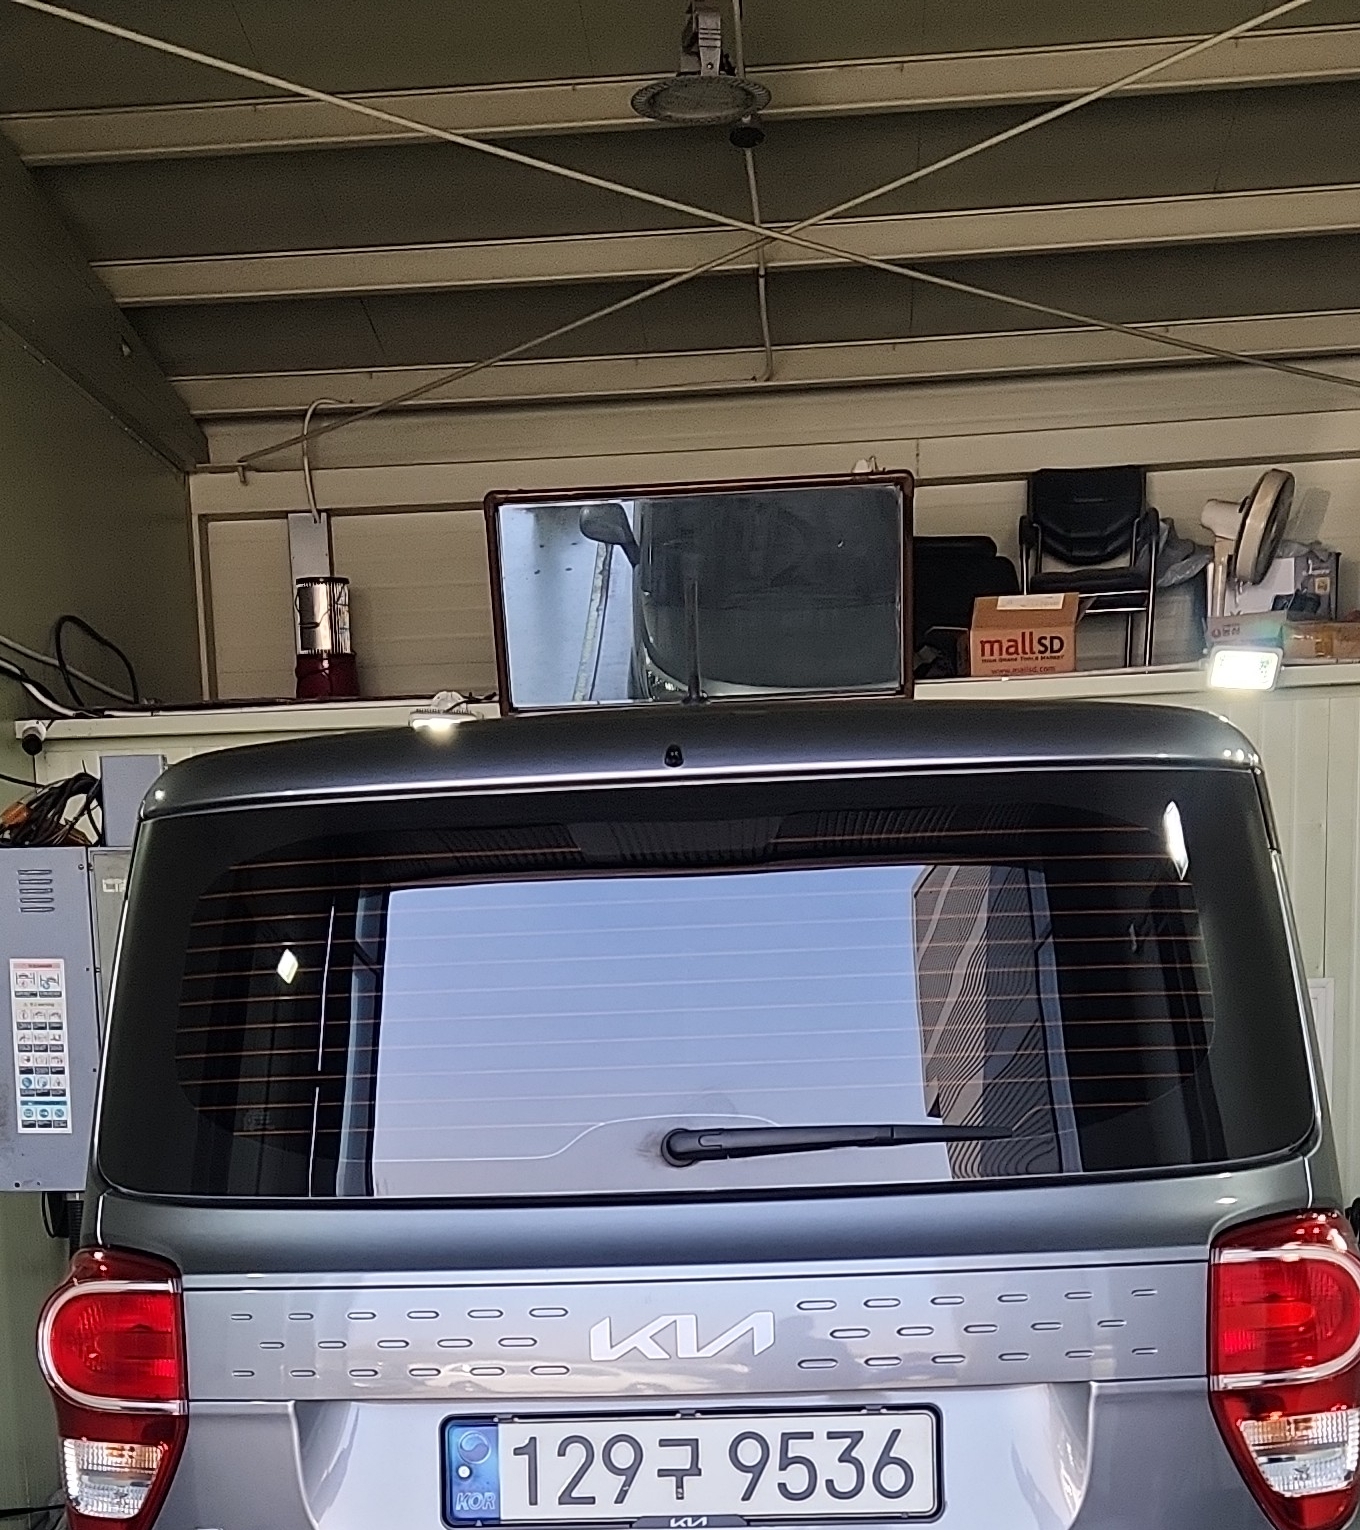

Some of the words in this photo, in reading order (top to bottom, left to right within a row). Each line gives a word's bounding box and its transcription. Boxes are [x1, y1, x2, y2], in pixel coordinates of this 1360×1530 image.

[590, 1311, 776, 1361] KIA
[512, 1434, 702, 1507] 129구
[728, 1428, 914, 1502] 9536
[455, 1492, 496, 1512] KOR
[669, 1516, 708, 1528] KIA
